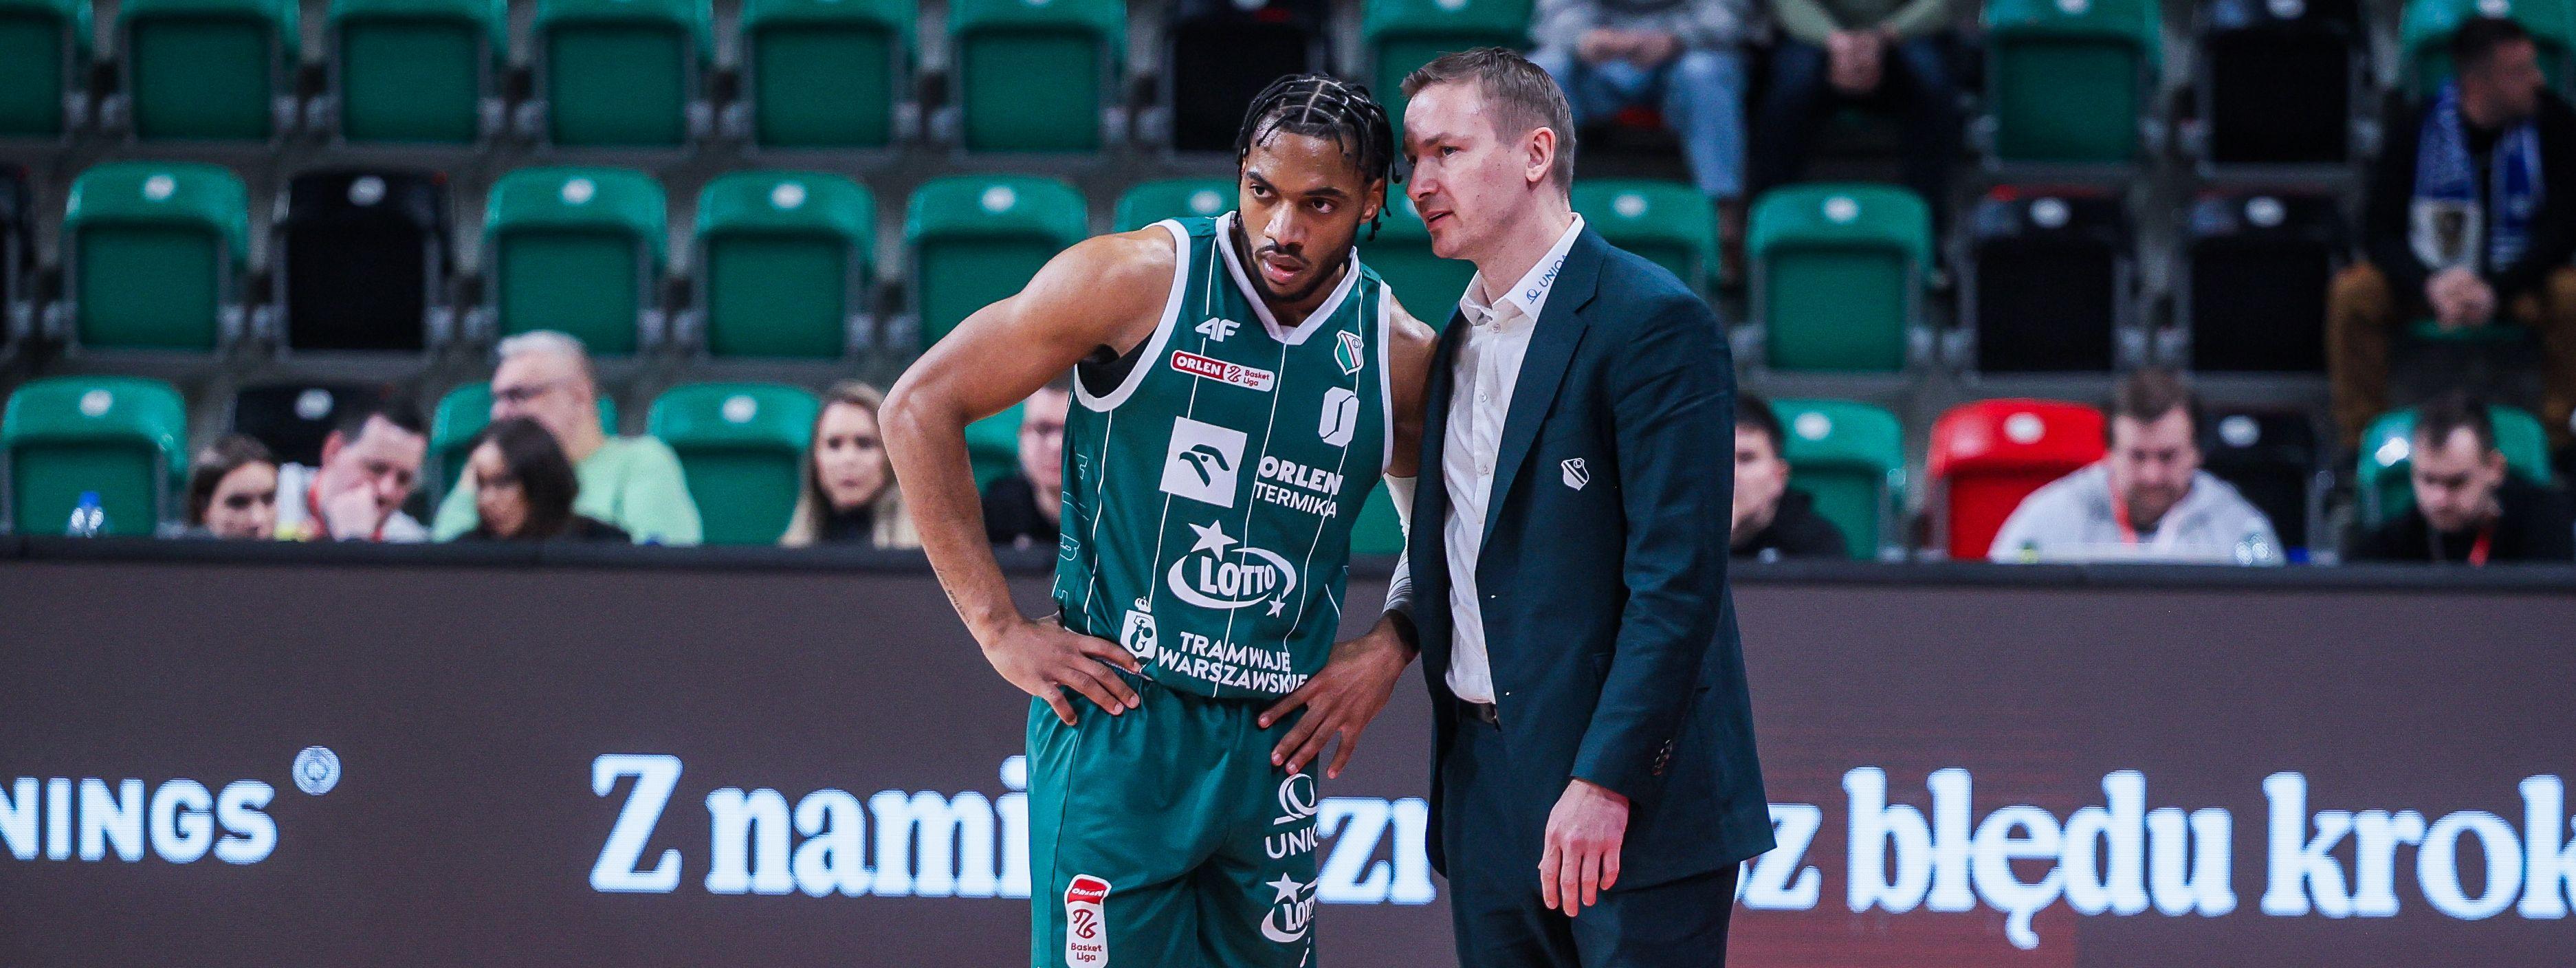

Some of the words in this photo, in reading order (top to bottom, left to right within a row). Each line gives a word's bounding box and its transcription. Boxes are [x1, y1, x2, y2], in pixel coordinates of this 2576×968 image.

[1195, 317, 1240, 342] 4F
[1176, 355, 1222, 376] ORLEN
[1243, 376, 1259, 386] Liga
[1244, 369, 1270, 381] Basket
[1258, 456, 1344, 495] ORLEN
[1255, 481, 1336, 518] TERMIKA
[1200, 556, 1276, 597] LOTTO
[1180, 631, 1291, 672] TRAMWAJE
[0, 776, 279, 864] NINGS
[589, 754, 684, 893] Z
[704, 755, 1031, 898] nami
[1842, 765, 2238, 950] błędu
[1070, 943, 1103, 952] Basket
[1077, 952, 1097, 962] Liga
